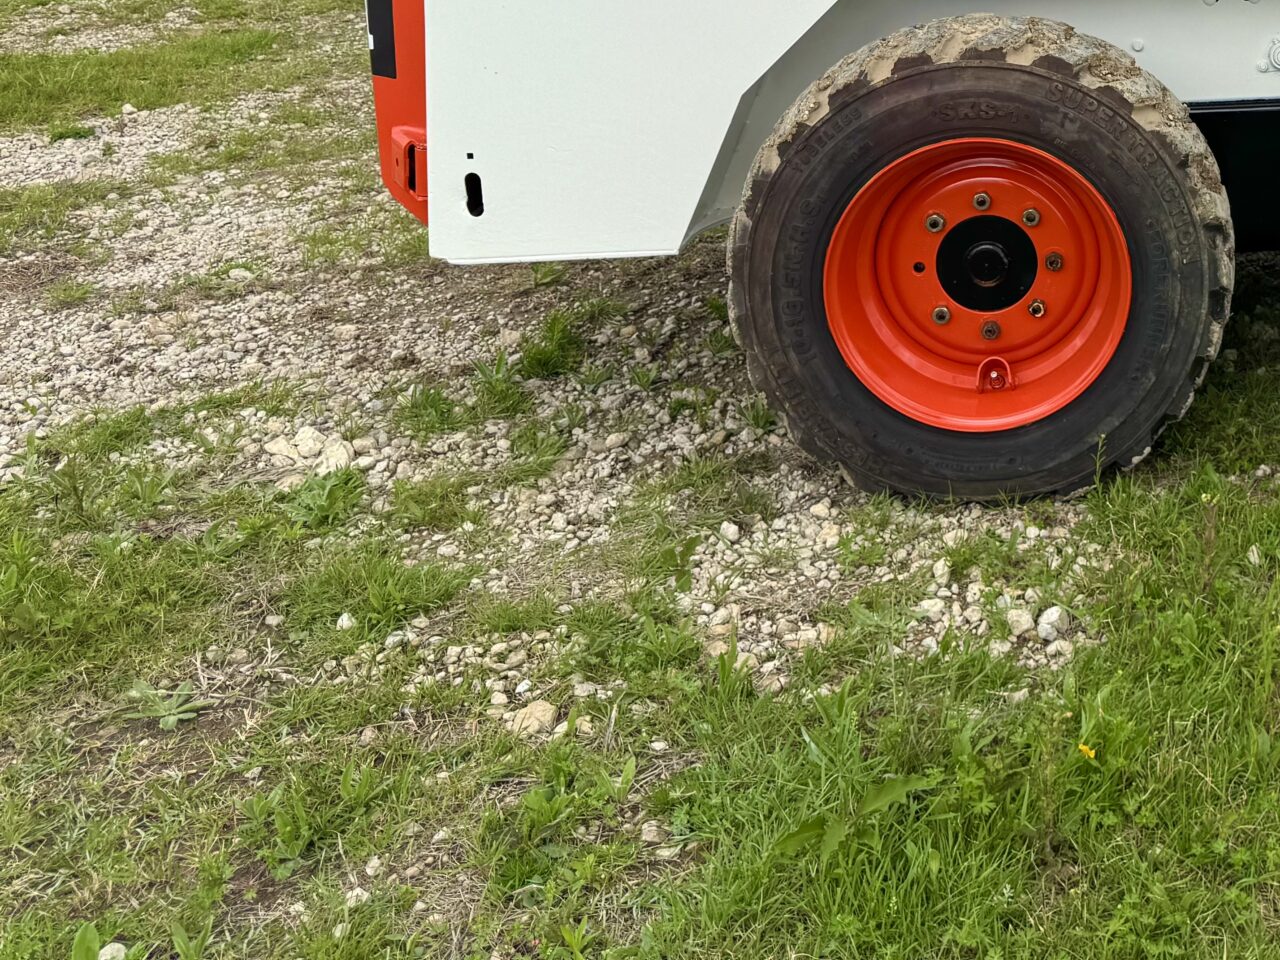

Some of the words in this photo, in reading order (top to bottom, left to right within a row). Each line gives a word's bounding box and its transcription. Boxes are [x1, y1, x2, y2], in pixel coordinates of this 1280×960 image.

[790, 106, 863, 173] TUBELESS
[1046, 80, 1126, 140] SUPER
[1128, 128, 1201, 265] TRACTION
